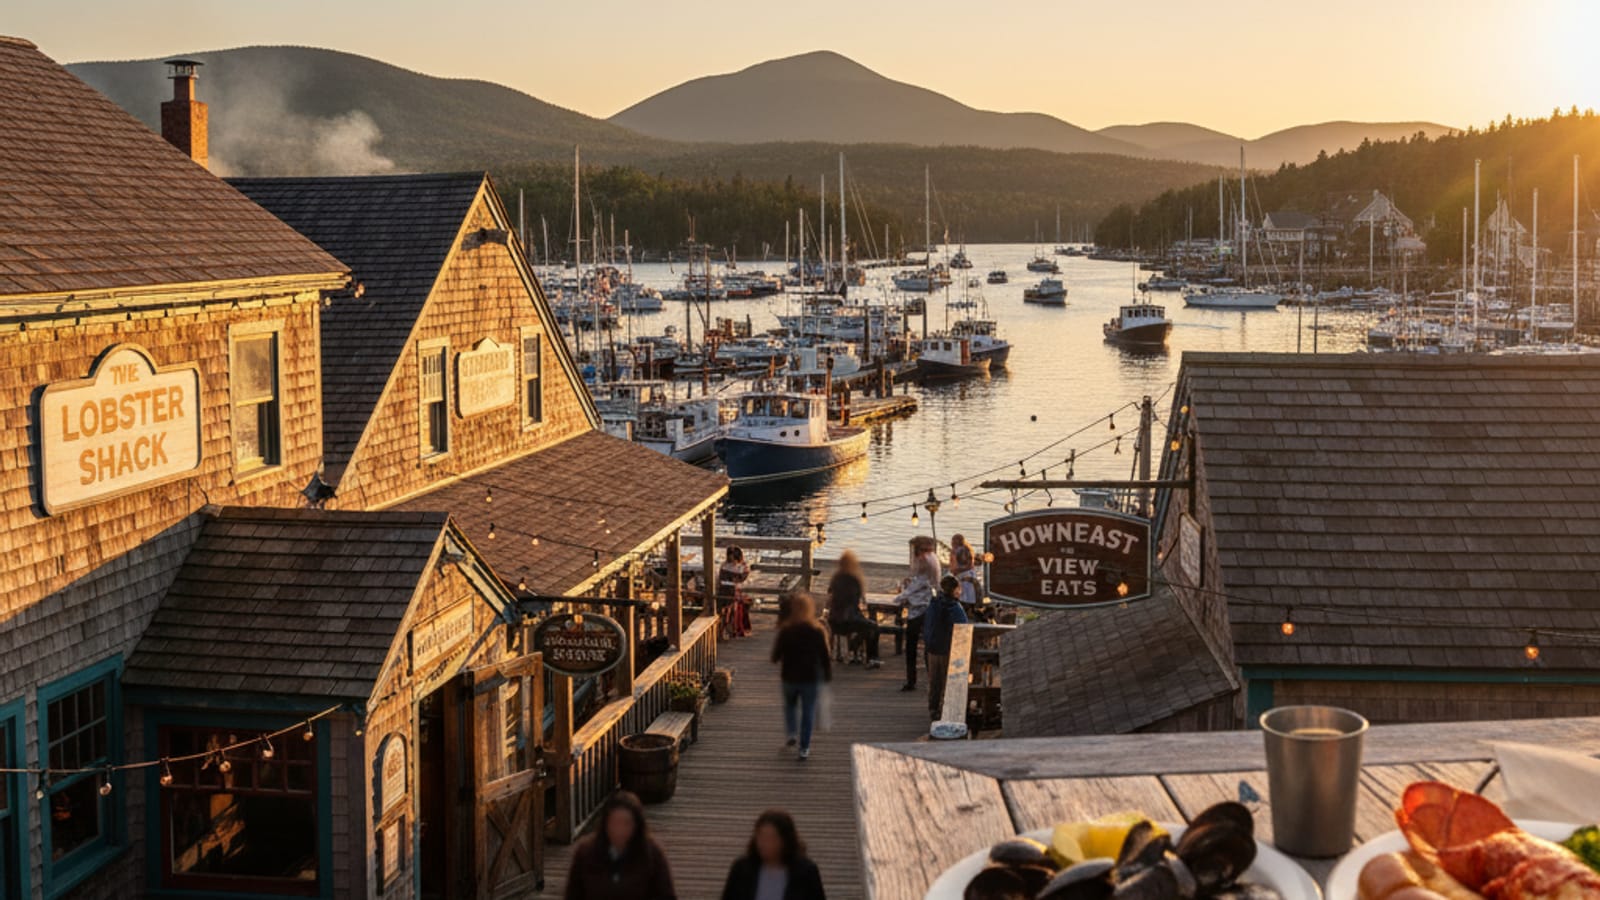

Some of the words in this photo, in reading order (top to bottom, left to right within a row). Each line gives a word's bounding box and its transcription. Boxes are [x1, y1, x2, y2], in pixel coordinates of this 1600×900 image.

[61, 385, 184, 442] LOBSTER
[79, 432, 168, 485] SHACK
[999, 522, 1139, 554] HOWNEAST
[1037, 557, 1099, 576] VIEW
[1041, 580, 1097, 596] EATS
